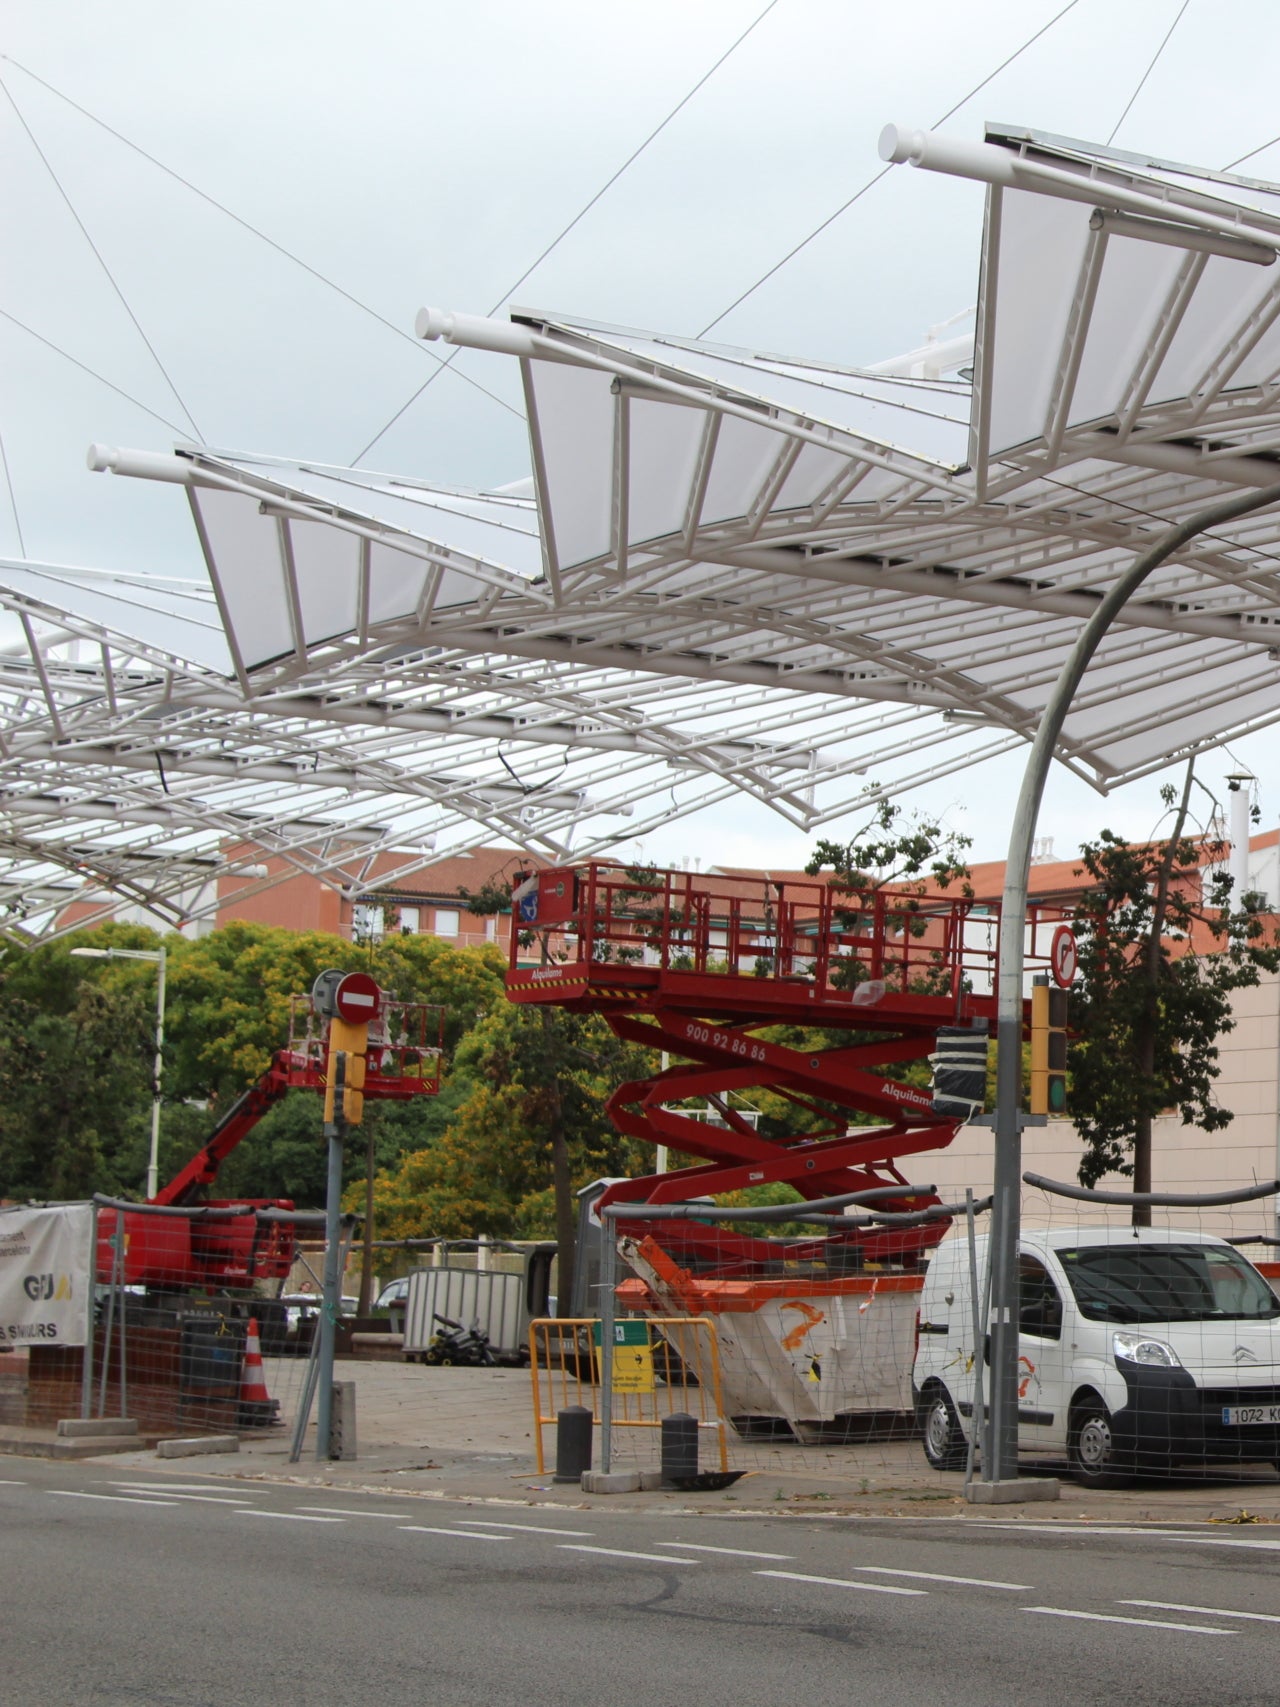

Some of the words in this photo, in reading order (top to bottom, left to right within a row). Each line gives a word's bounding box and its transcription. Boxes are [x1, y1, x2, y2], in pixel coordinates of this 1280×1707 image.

[686, 1023, 709, 1042] 900
[713, 1033, 728, 1048] 92
[732, 1039, 747, 1055] 86
[751, 1045, 765, 1061] 86
[1235, 1408, 1264, 1424] 1072
